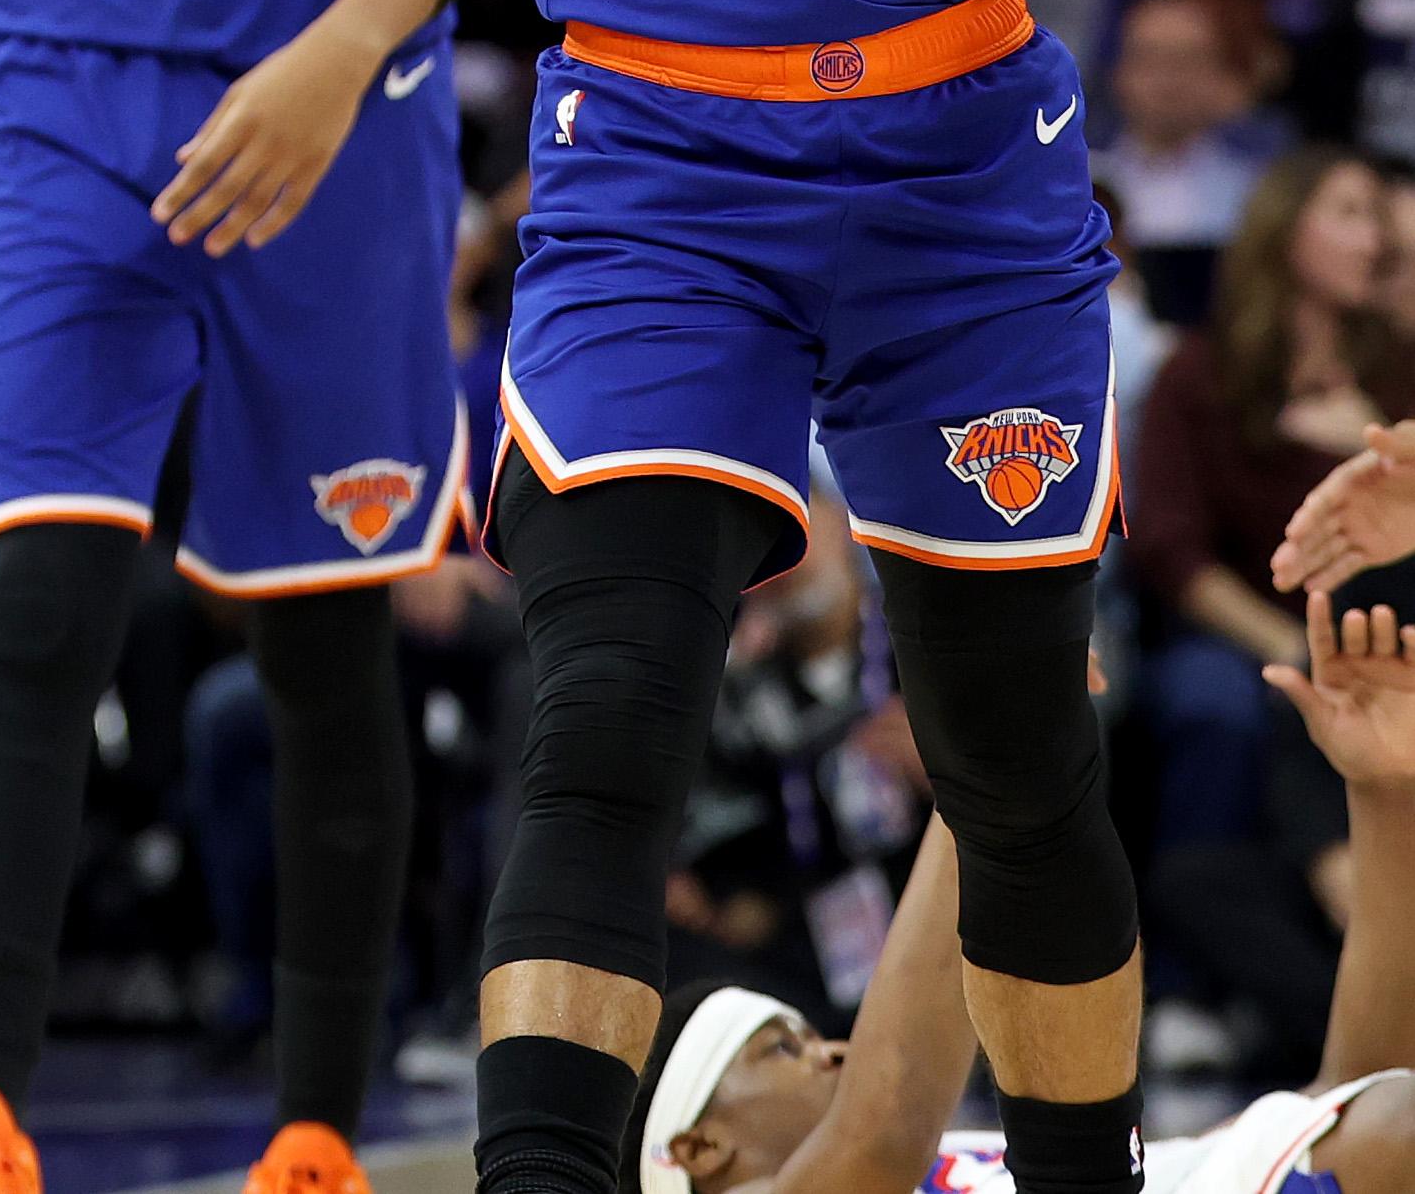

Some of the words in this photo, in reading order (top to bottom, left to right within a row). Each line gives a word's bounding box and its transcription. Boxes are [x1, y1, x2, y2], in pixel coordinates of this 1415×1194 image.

[817, 55, 858, 79] KNICKS
[992, 413, 1014, 426] NEW
[1016, 412, 1041, 424] YORK
[952, 420, 1074, 466] KNICKS
